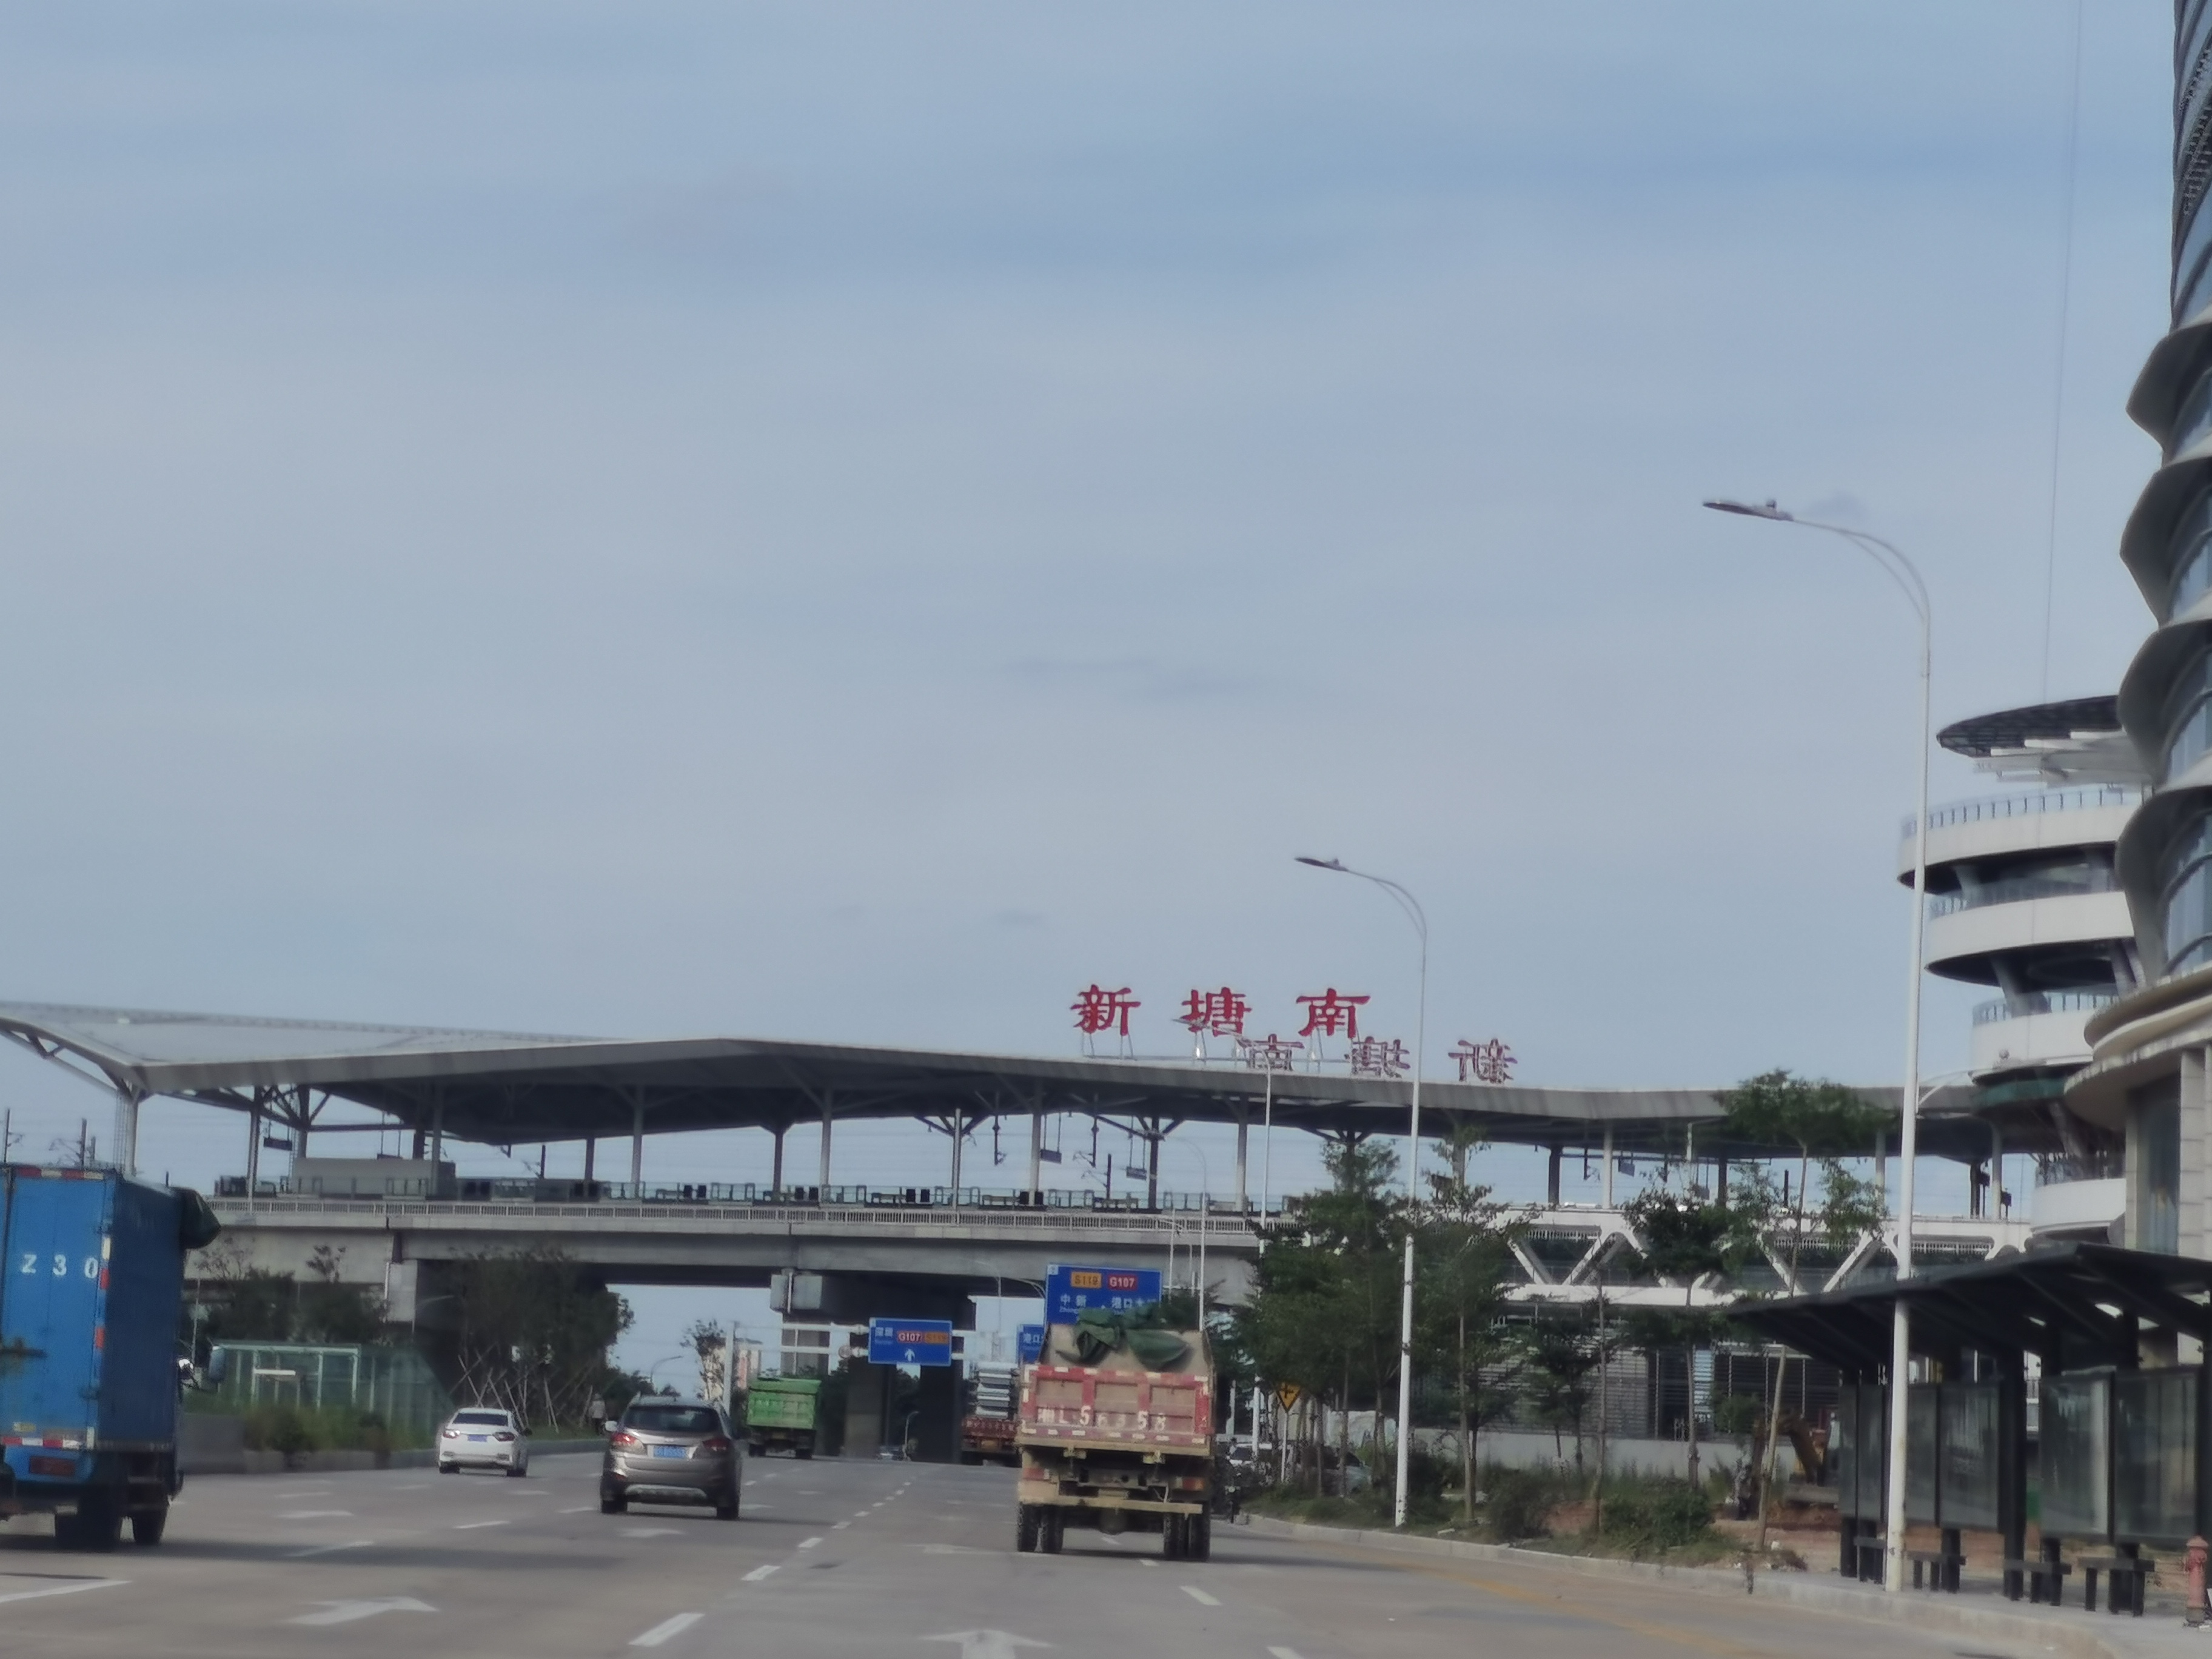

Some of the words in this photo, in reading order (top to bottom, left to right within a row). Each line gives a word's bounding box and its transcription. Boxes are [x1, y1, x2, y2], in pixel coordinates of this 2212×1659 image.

[1070, 984, 1370, 1038] 新塘南
[1109, 1276, 1135, 1288] G107
[898, 1332, 921, 1342] G107
